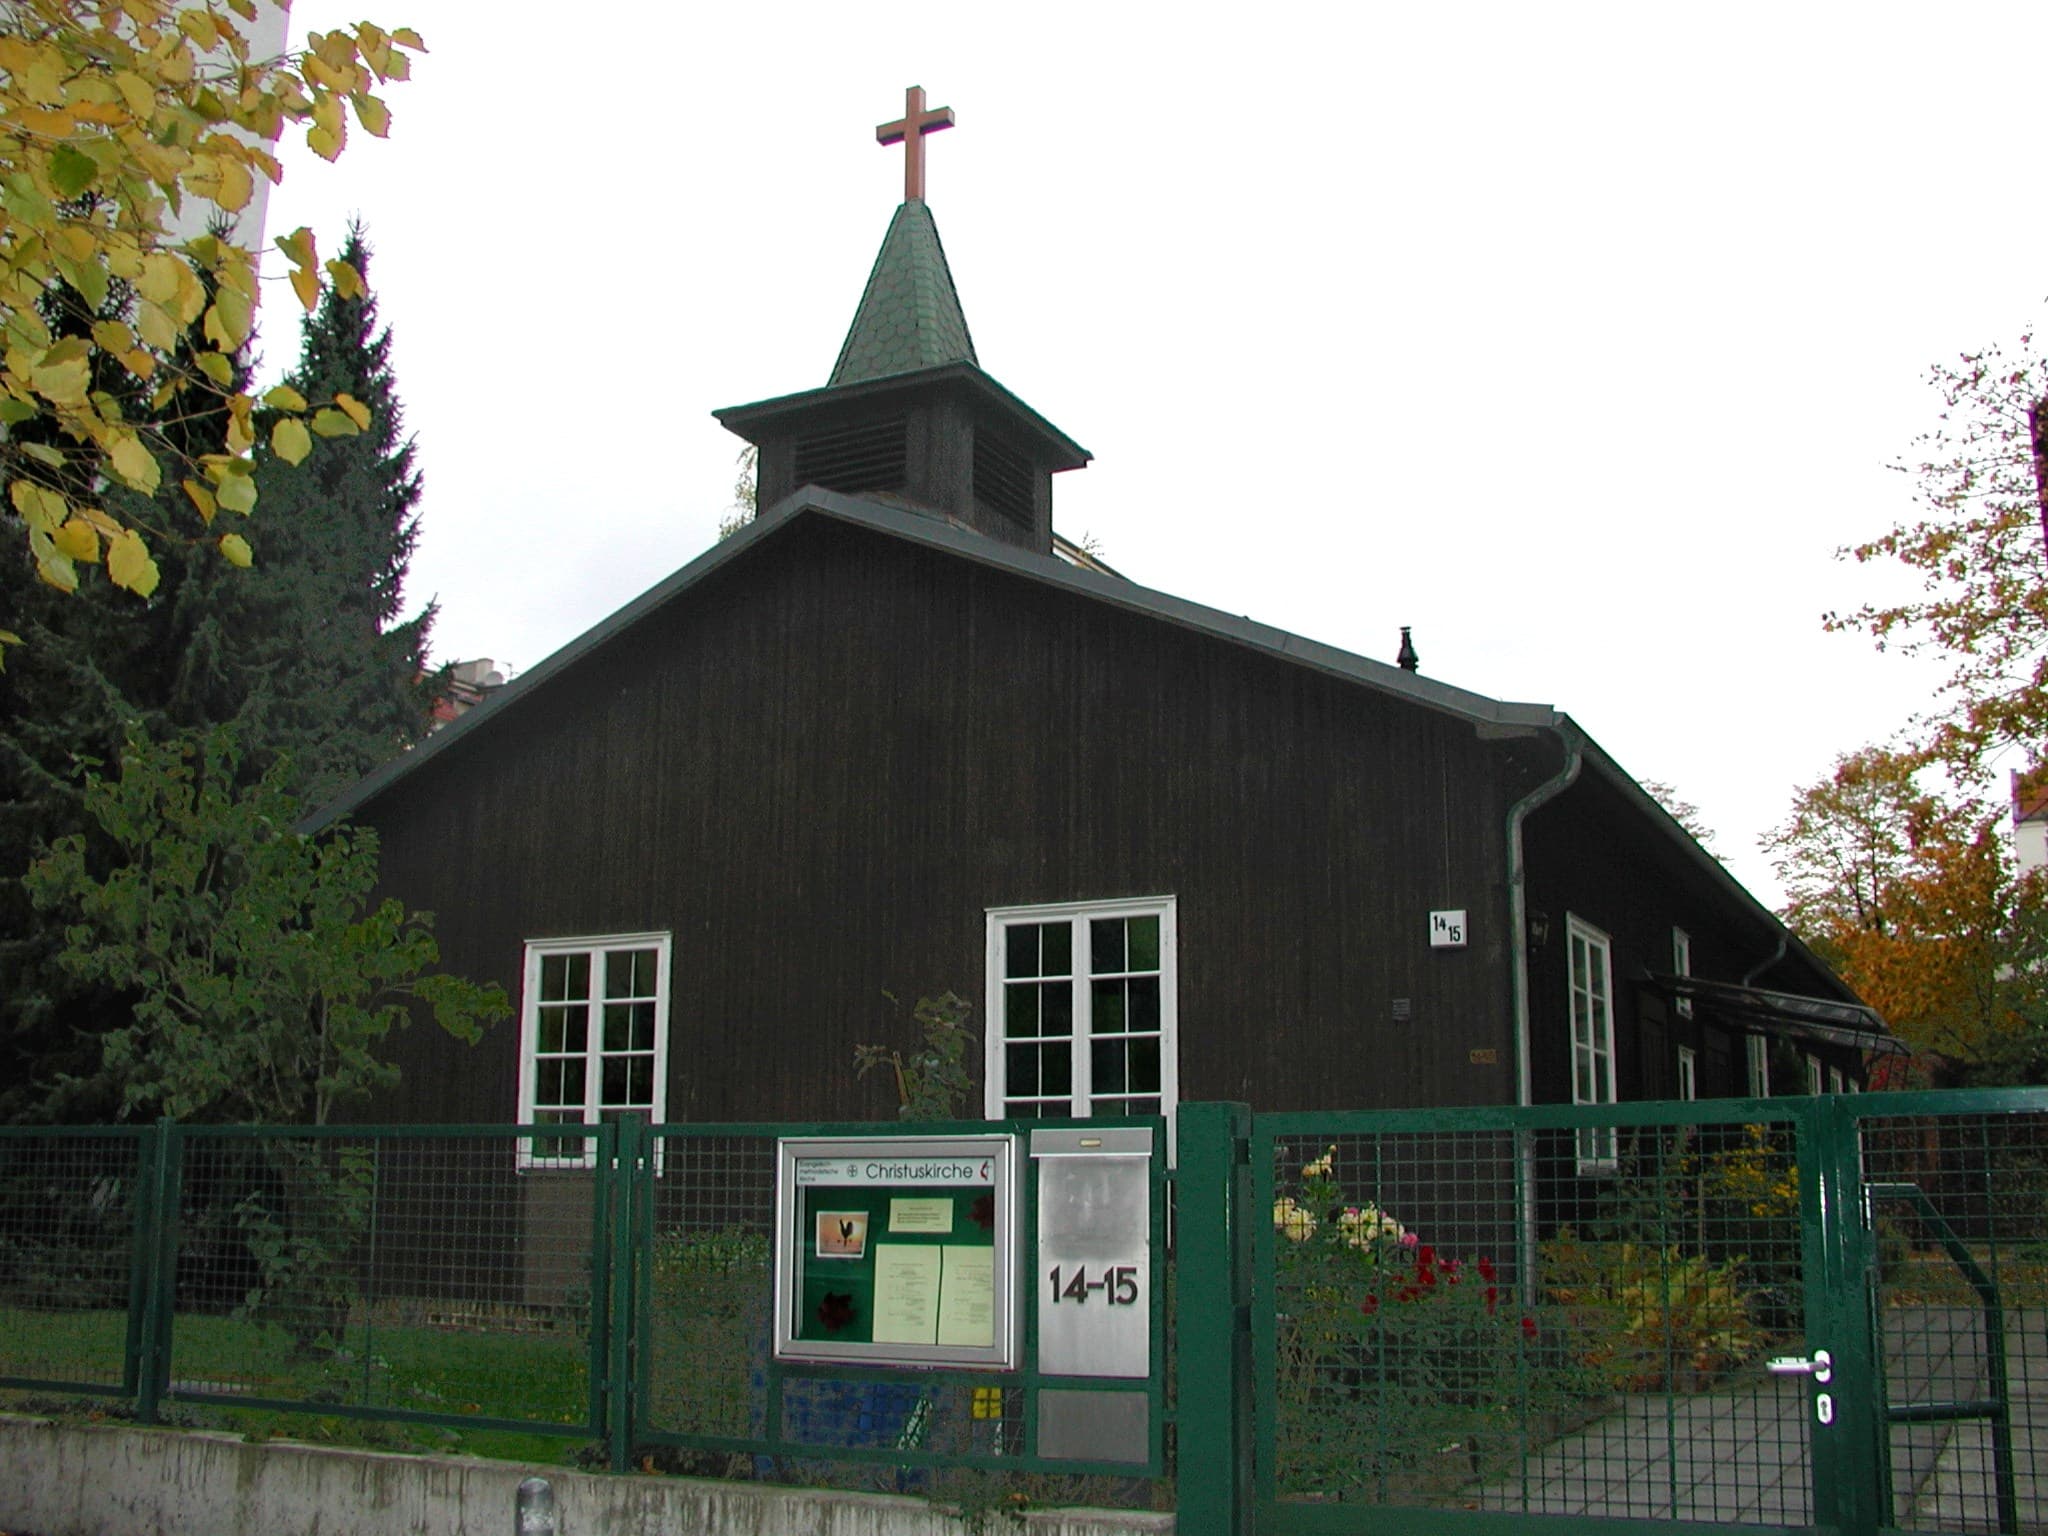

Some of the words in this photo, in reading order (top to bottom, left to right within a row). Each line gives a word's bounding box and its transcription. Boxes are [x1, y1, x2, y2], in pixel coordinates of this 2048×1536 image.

[1433, 915, 1446, 931] 14
[1448, 925, 1461, 942] 15
[866, 1163, 974, 1179] Christuskirche
[1049, 1264, 1138, 1305] 14-15
